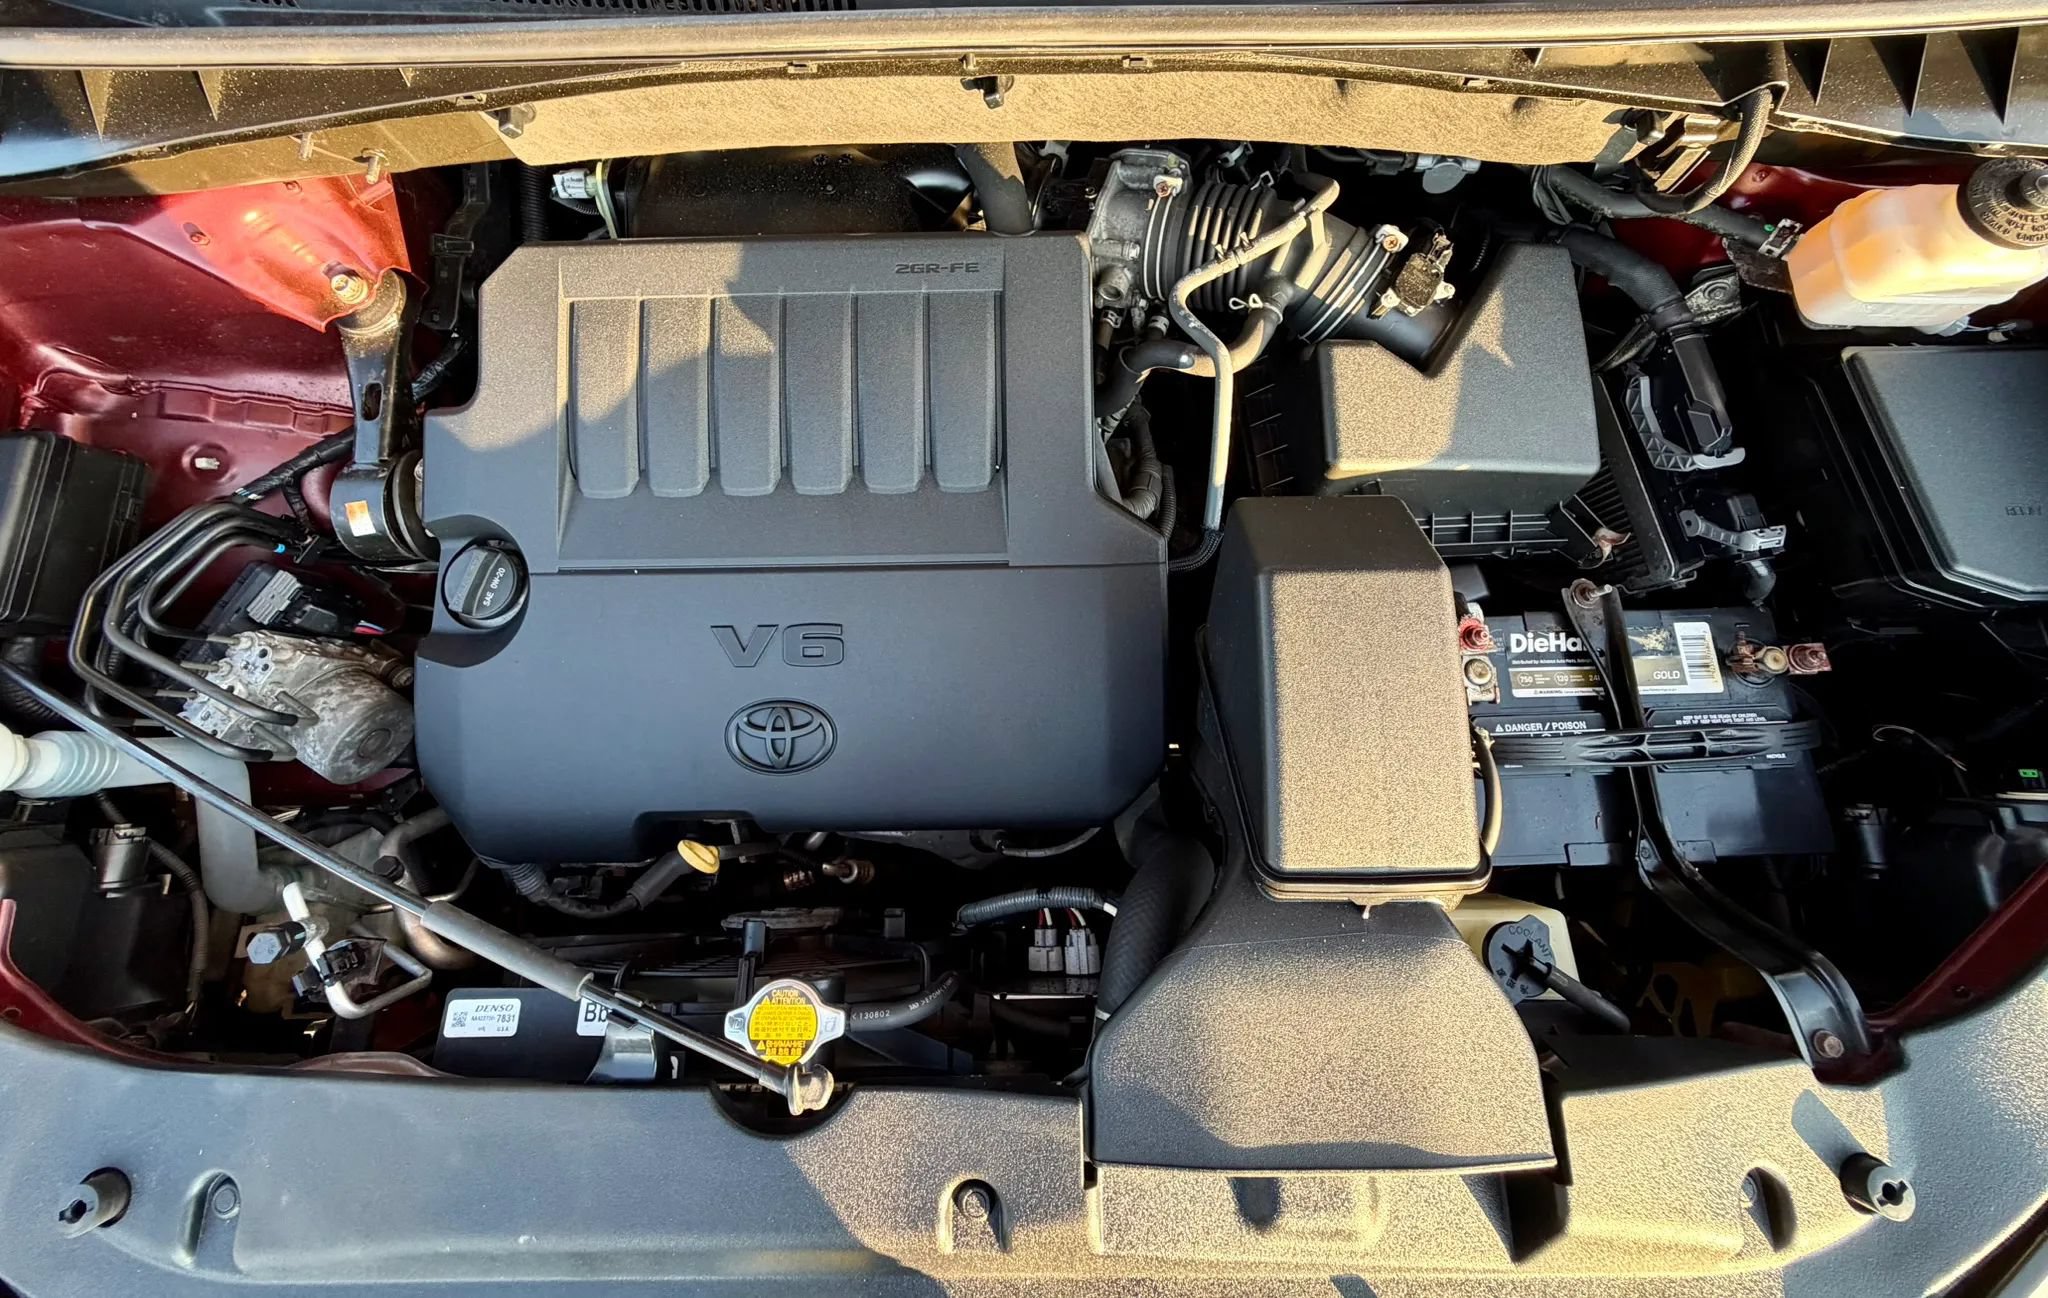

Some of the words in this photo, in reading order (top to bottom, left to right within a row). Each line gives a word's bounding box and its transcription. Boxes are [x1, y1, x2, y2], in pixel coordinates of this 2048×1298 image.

[895, 262, 980, 274] 2GR-FE
[482, 591, 495, 607] SAE
[490, 567, 506, 589] 0W-20
[710, 622, 845, 668] V6
[1509, 632, 1588, 653] DieHa
[1519, 675, 1533, 683] 750
[1653, 670, 1680, 680] GOLD
[1505, 722, 1543, 732] DANGER
[1552, 721, 1587, 730] POISON
[1508, 925, 1554, 958] COOLANT
[771, 997, 806, 1005] ATTENTION
[475, 1004, 514, 1013] DENSO
[496, 1014, 516, 1023] 7831
